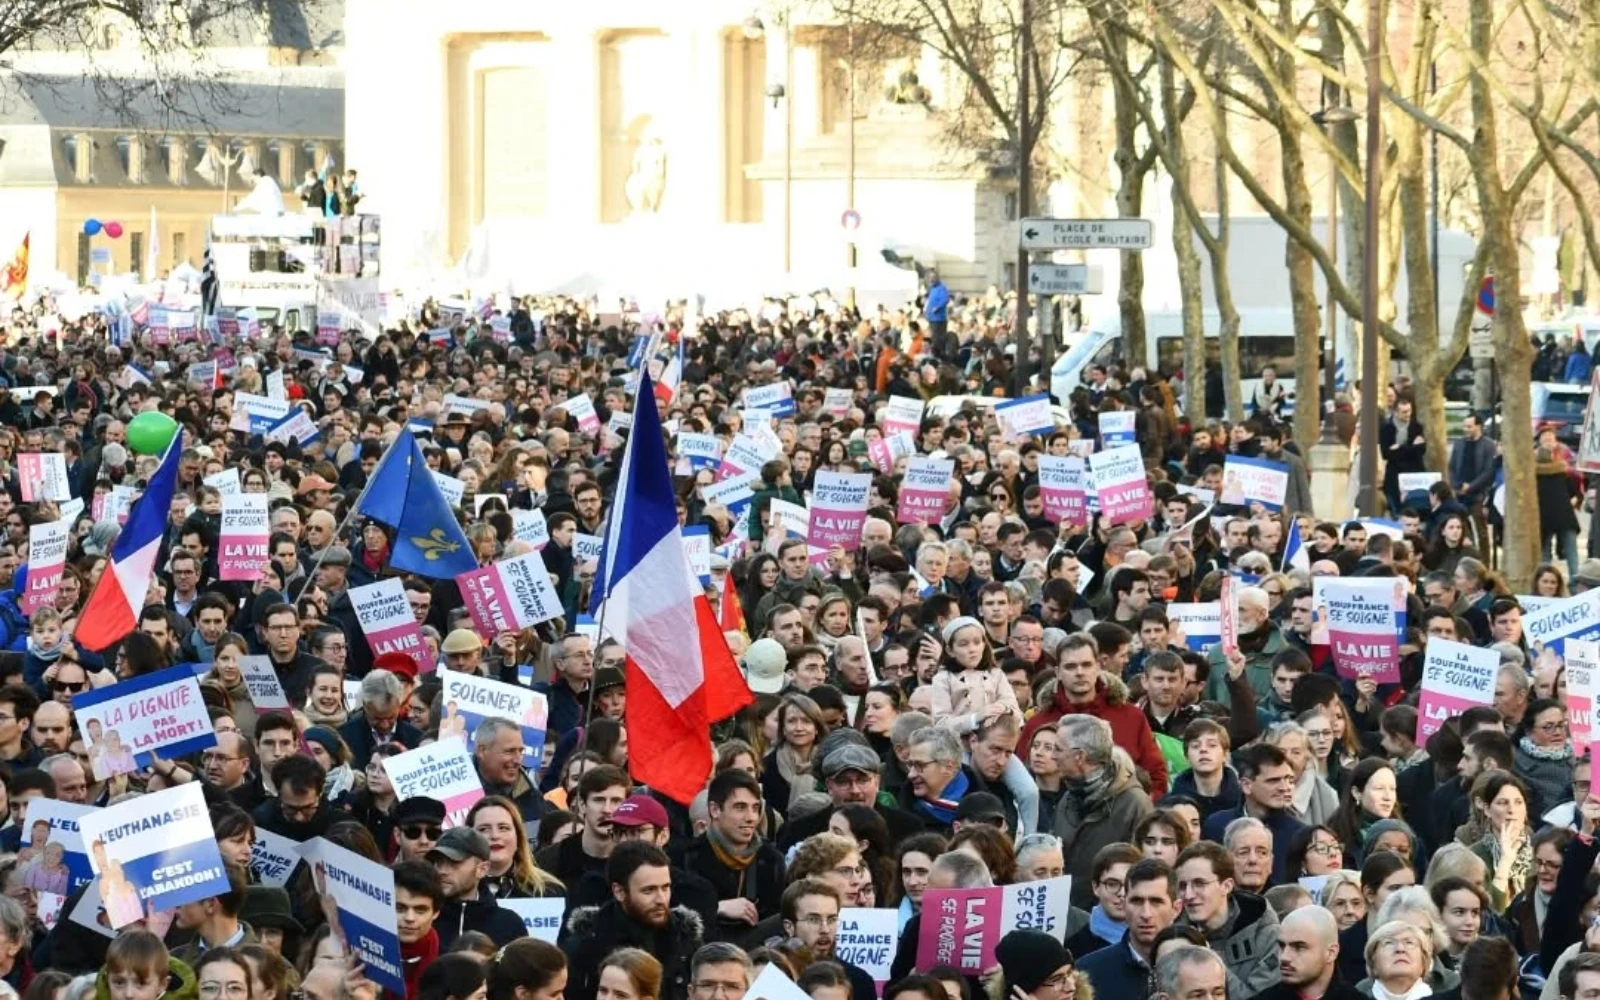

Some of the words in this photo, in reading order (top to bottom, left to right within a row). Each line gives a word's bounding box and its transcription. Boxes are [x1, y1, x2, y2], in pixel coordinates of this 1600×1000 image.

[1053, 224, 1086, 232] PLACE
[1091, 224, 1104, 232] DE
[1097, 236, 1147, 244] MILITAIRE
[905, 495, 922, 506] LA
[924, 498, 943, 507] VIE
[1045, 495, 1060, 506] LA
[1060, 497, 1082, 508] VIE
[1104, 494, 1122, 506] LA
[1122, 488, 1145, 501] VIE
[814, 516, 834, 529] LA
[836, 519, 860, 530] VIE
[224, 544, 243, 556] LA
[246, 544, 268, 556] VIE
[577, 542, 602, 556] SOIG
[32, 576, 48, 590] LA
[519, 559, 547, 617] SOUFFRANCE
[536, 580, 545, 592] LA
[372, 590, 382, 598] LA
[1352, 594, 1364, 602] LA
[478, 575, 496, 600] LA
[488, 600, 511, 630] VIE
[1328, 600, 1390, 610] SOUFFRANCE
[1330, 609, 1343, 621] SE
[374, 640, 394, 655] LA
[392, 633, 420, 650] VIE
[1336, 640, 1358, 656] LA
[1360, 644, 1392, 658] VIE
[1456, 652, 1468, 662] LA
[1427, 666, 1442, 680] SE
[1430, 656, 1494, 677] SOUFFRANCE
[104, 708, 124, 728] LA
[1424, 703, 1446, 720] LA
[152, 715, 177, 729] PAS
[133, 734, 154, 748] LA
[154, 721, 195, 742] MORT
[420, 754, 434, 764] LA
[395, 755, 464, 784] SOUFFRANCE
[400, 782, 418, 798] SE
[99, 804, 200, 845] L'EUTHANASIE
[252, 848, 292, 867] RANCE
[151, 860, 193, 881] C'EST
[140, 868, 214, 900] L'ABANDON
[322, 860, 392, 906] L'EUTHANASIE
[1018, 887, 1035, 907] SE
[942, 898, 958, 914] SE
[965, 898, 986, 929] LA
[524, 916, 559, 928] ASIE
[842, 920, 859, 930] LA
[360, 935, 385, 957] C'EST
[960, 932, 983, 968] VIE
